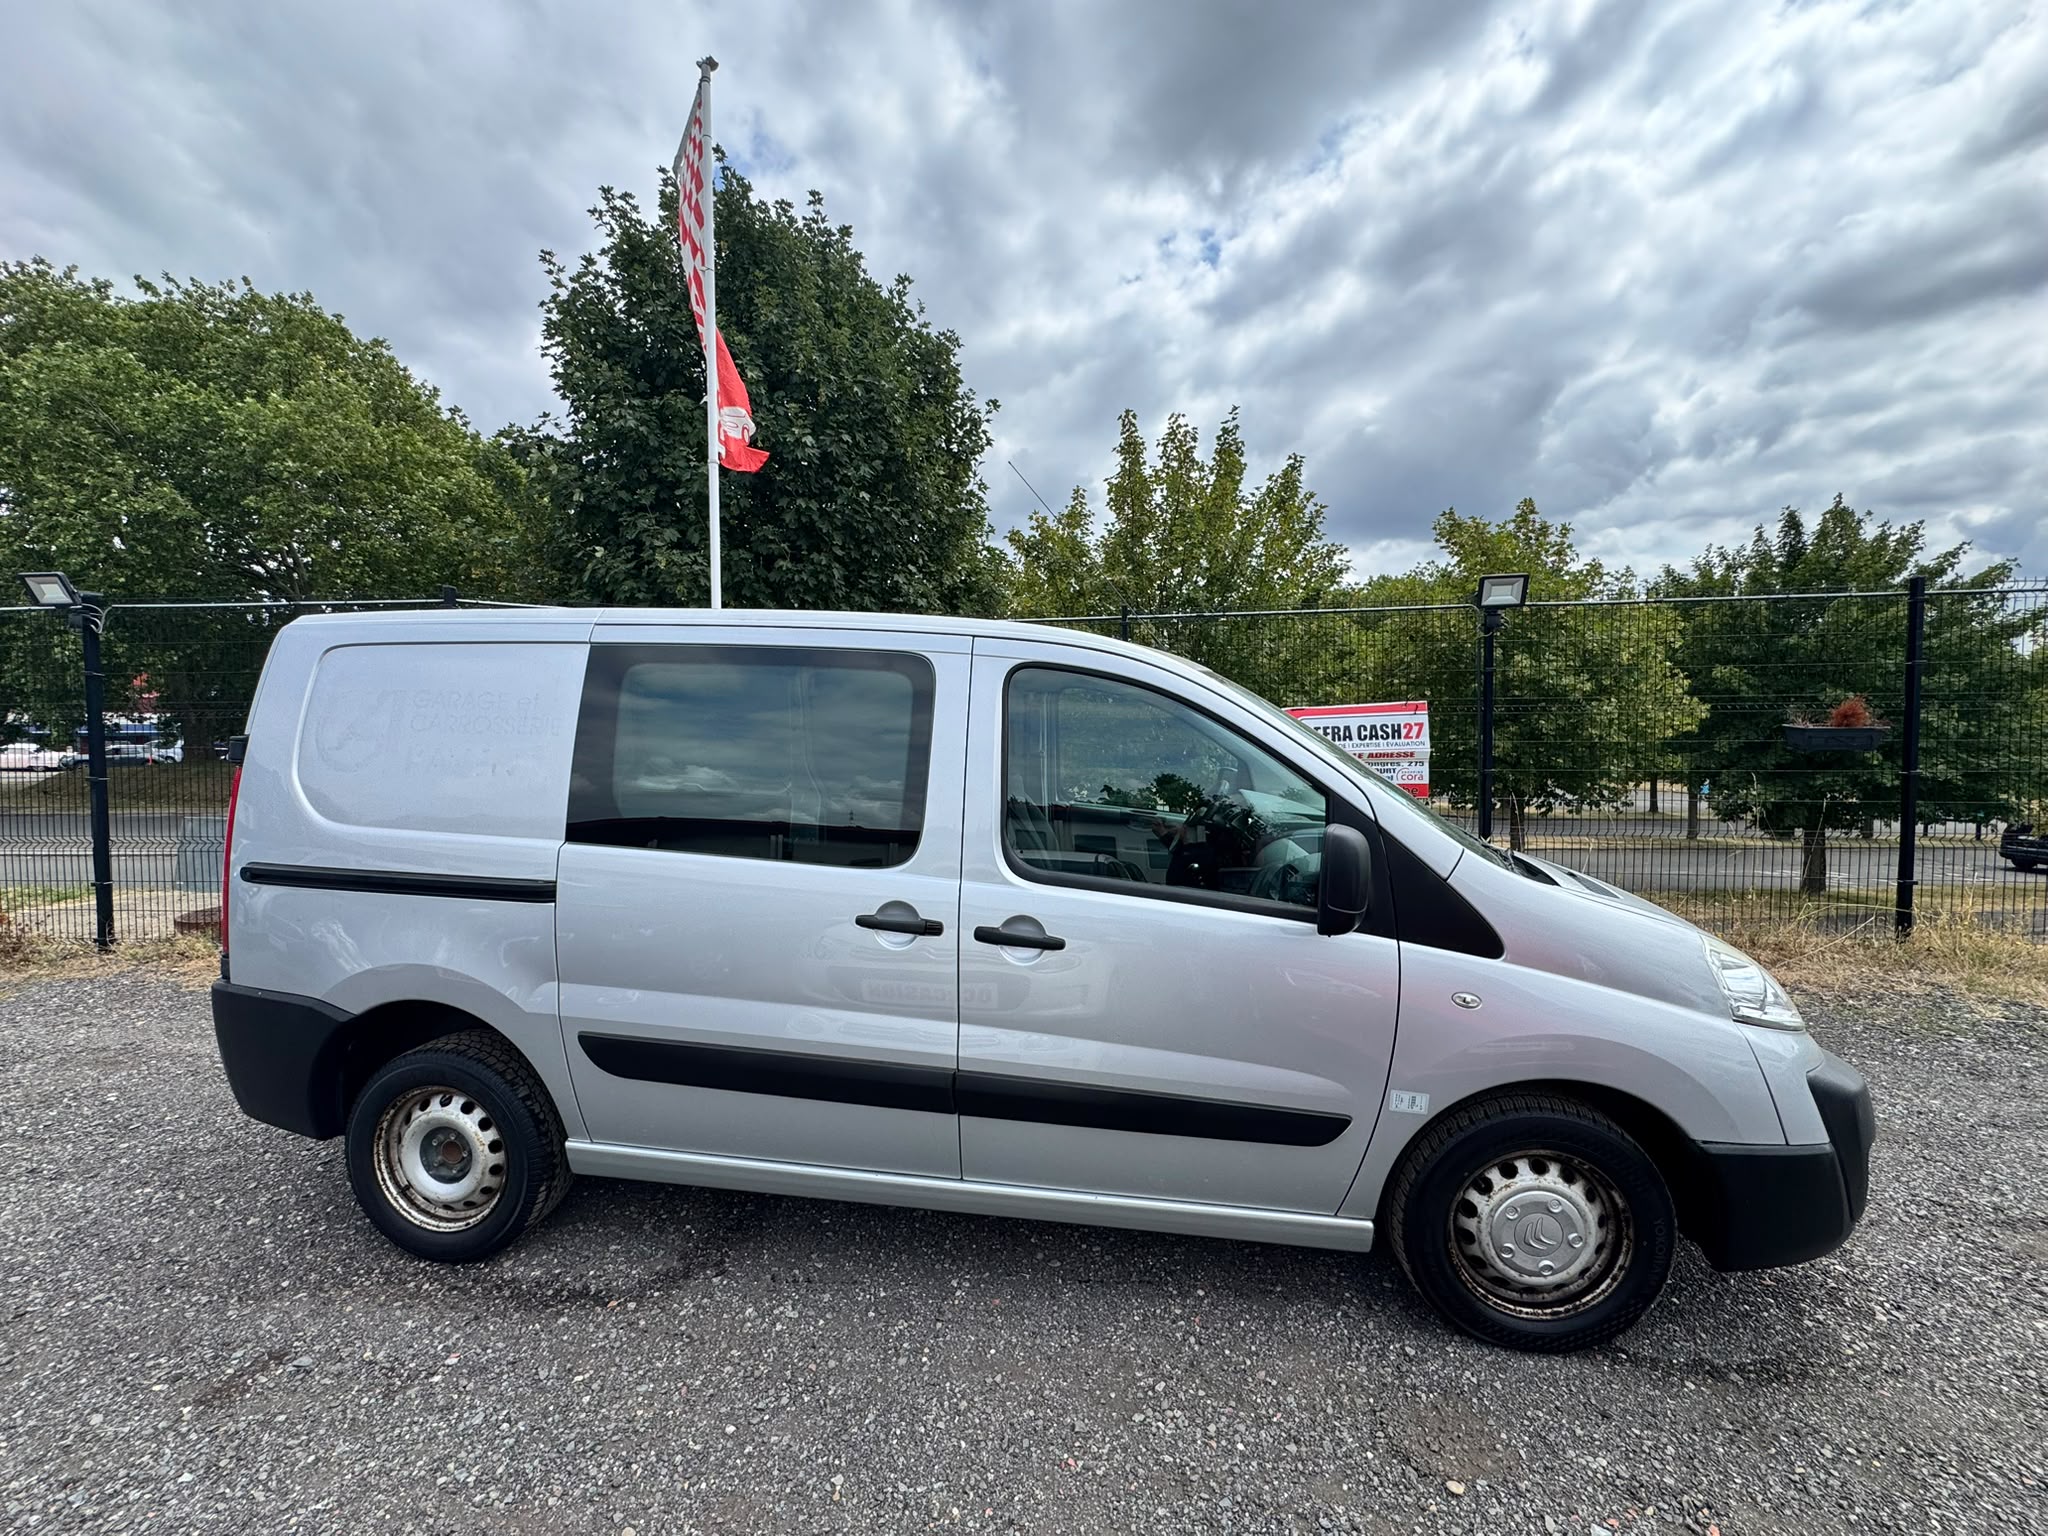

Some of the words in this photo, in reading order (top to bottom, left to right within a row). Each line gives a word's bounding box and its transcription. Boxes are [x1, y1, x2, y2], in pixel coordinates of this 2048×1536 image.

[1313, 725, 1353, 742] ERA
[1366, 751, 1416, 759] ADRESSE
[1400, 773, 1424, 781] cora
